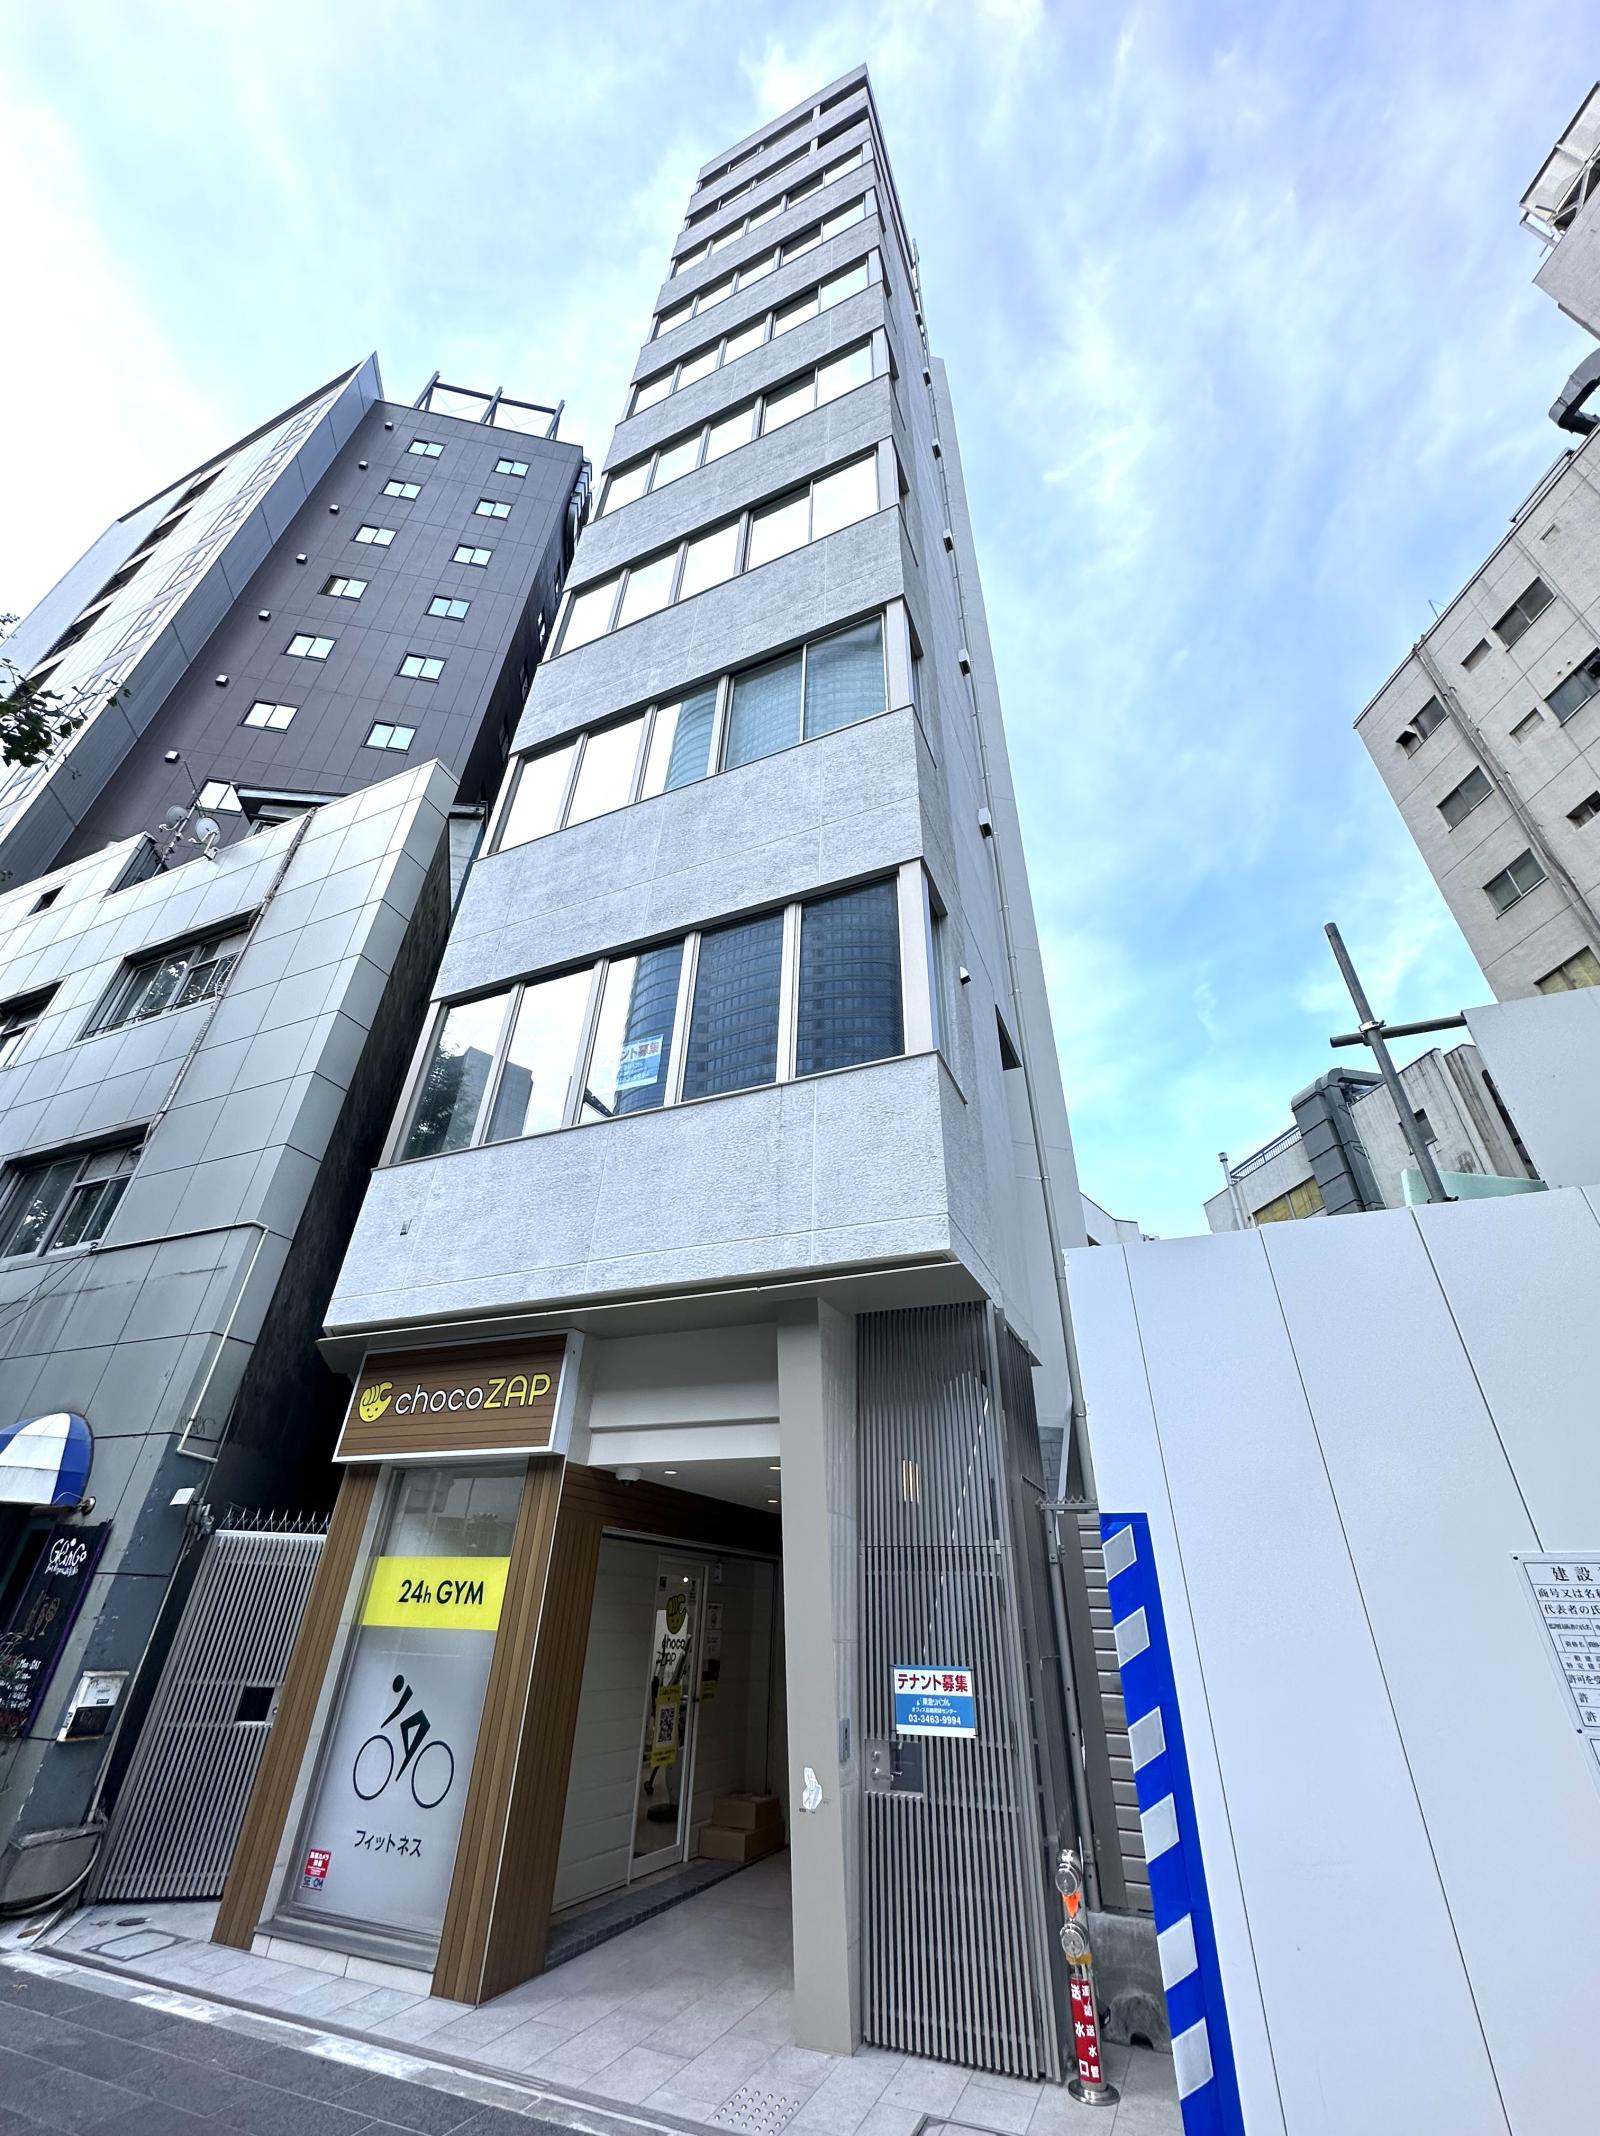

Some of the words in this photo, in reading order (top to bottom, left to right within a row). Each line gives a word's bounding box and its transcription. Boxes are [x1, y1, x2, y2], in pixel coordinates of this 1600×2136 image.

[394, 1373, 551, 1415] chocoZAP
[397, 1579, 432, 1604] 24h
[436, 1580, 484, 1605] GYM
[897, 1673, 968, 1692] テナント募集
[908, 1714, 961, 1725] 03-3463-9994
[354, 1829, 422, 1857] フィットネス
